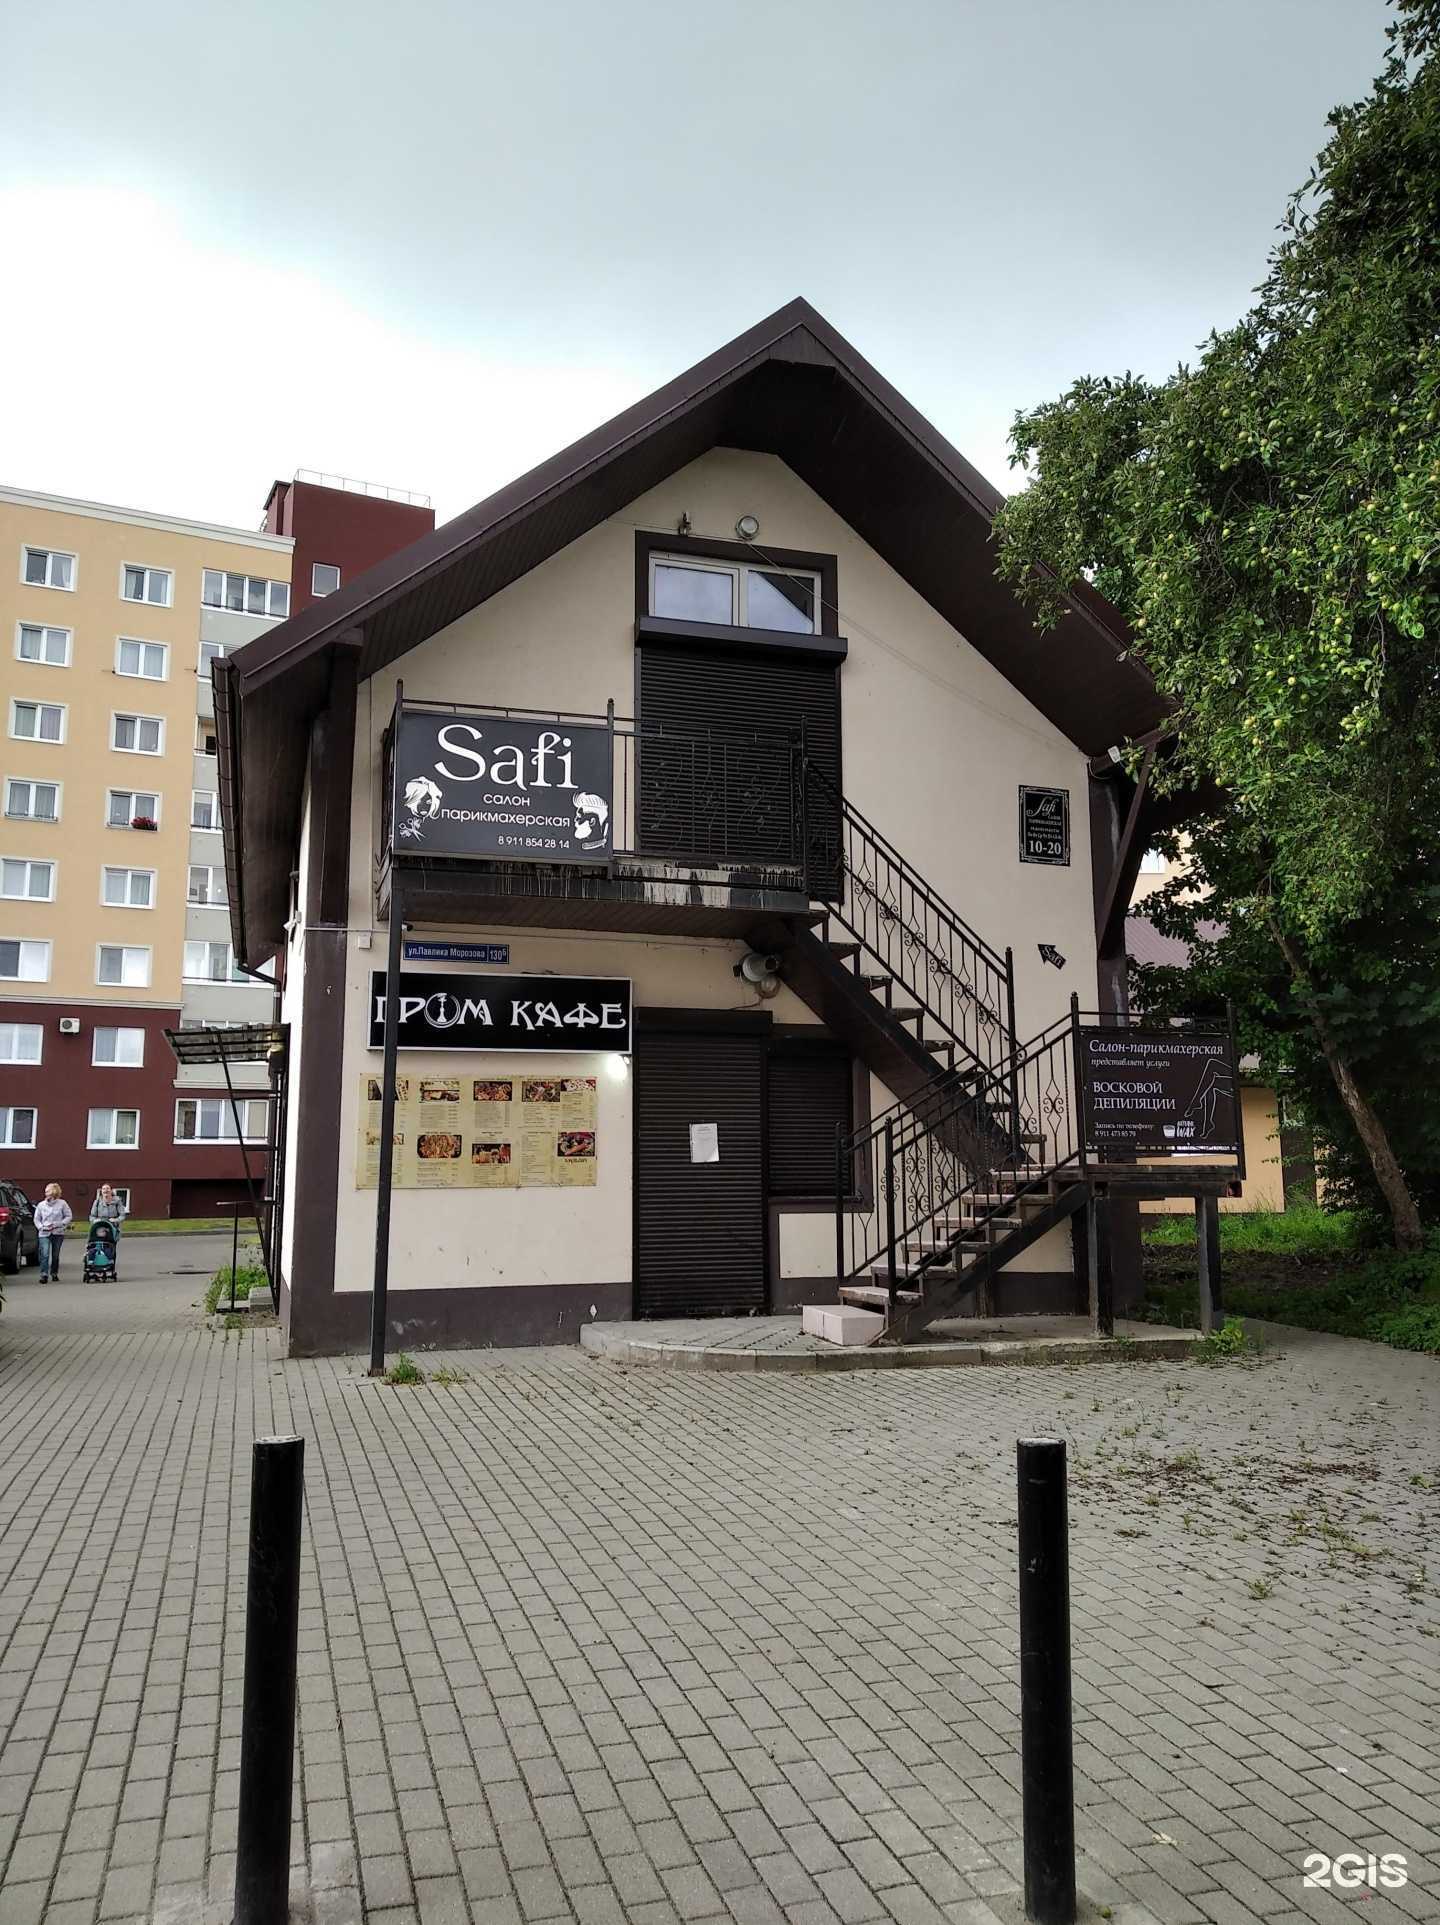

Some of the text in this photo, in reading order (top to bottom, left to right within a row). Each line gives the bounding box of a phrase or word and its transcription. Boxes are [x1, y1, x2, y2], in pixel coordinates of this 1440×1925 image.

[434, 724, 579, 791] Safi
[483, 793, 531, 807] салон
[441, 808, 570, 828] парикмахерская
[498, 836, 570, 849] 8 911 854 28 14
[1030, 840, 1062, 855] 10-20
[449, 948, 485, 959] Морозова
[510, 1000, 627, 1030] КАФЕ
[1089, 1040, 1223, 1058] Салон-парикмахерская
[1091, 1058, 1170, 1070] представляет услуги
[1093, 1081, 1163, 1094] ВОСКОВОЙ
[1094, 1097, 1176, 1111] ДЕПИЛЯЦИИ
[1176, 1126, 1196, 1138] WAX
